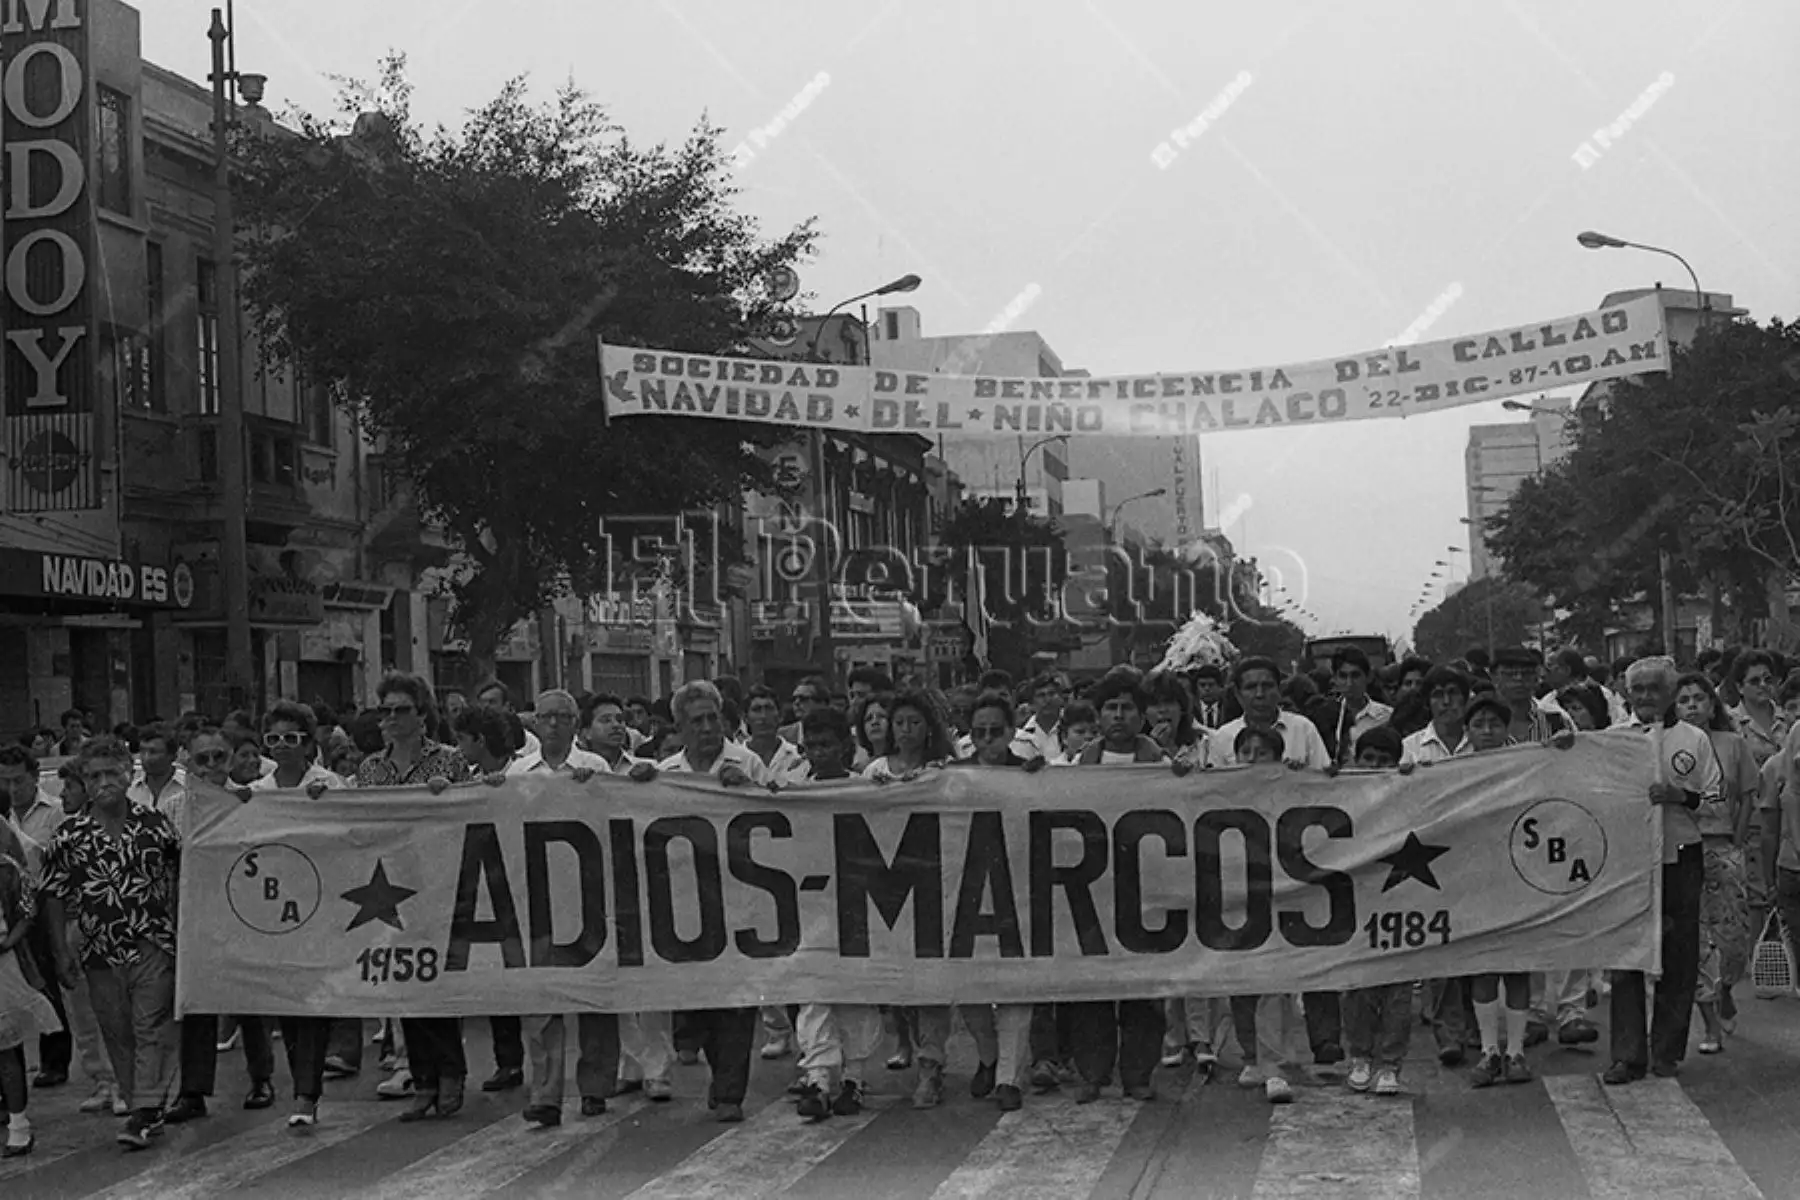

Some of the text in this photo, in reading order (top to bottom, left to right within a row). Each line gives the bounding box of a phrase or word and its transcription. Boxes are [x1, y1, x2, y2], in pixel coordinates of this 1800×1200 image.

[633, 354, 839, 388] SOCIEDAD
[875, 371, 929, 394] DE
[974, 369, 1293, 399] BENEFICENCIA
[1335, 349, 1421, 383] DEL
[1452, 308, 1629, 362] CALLAO
[640, 378, 834, 423] NAVIDAD
[872, 400, 963, 430] DEL
[993, 402, 1103, 432] NIÑO
[1130, 388, 1347, 432] CHALACO
[43, 554, 134, 599] NAVIDAD
[141, 564, 168, 602] ES
